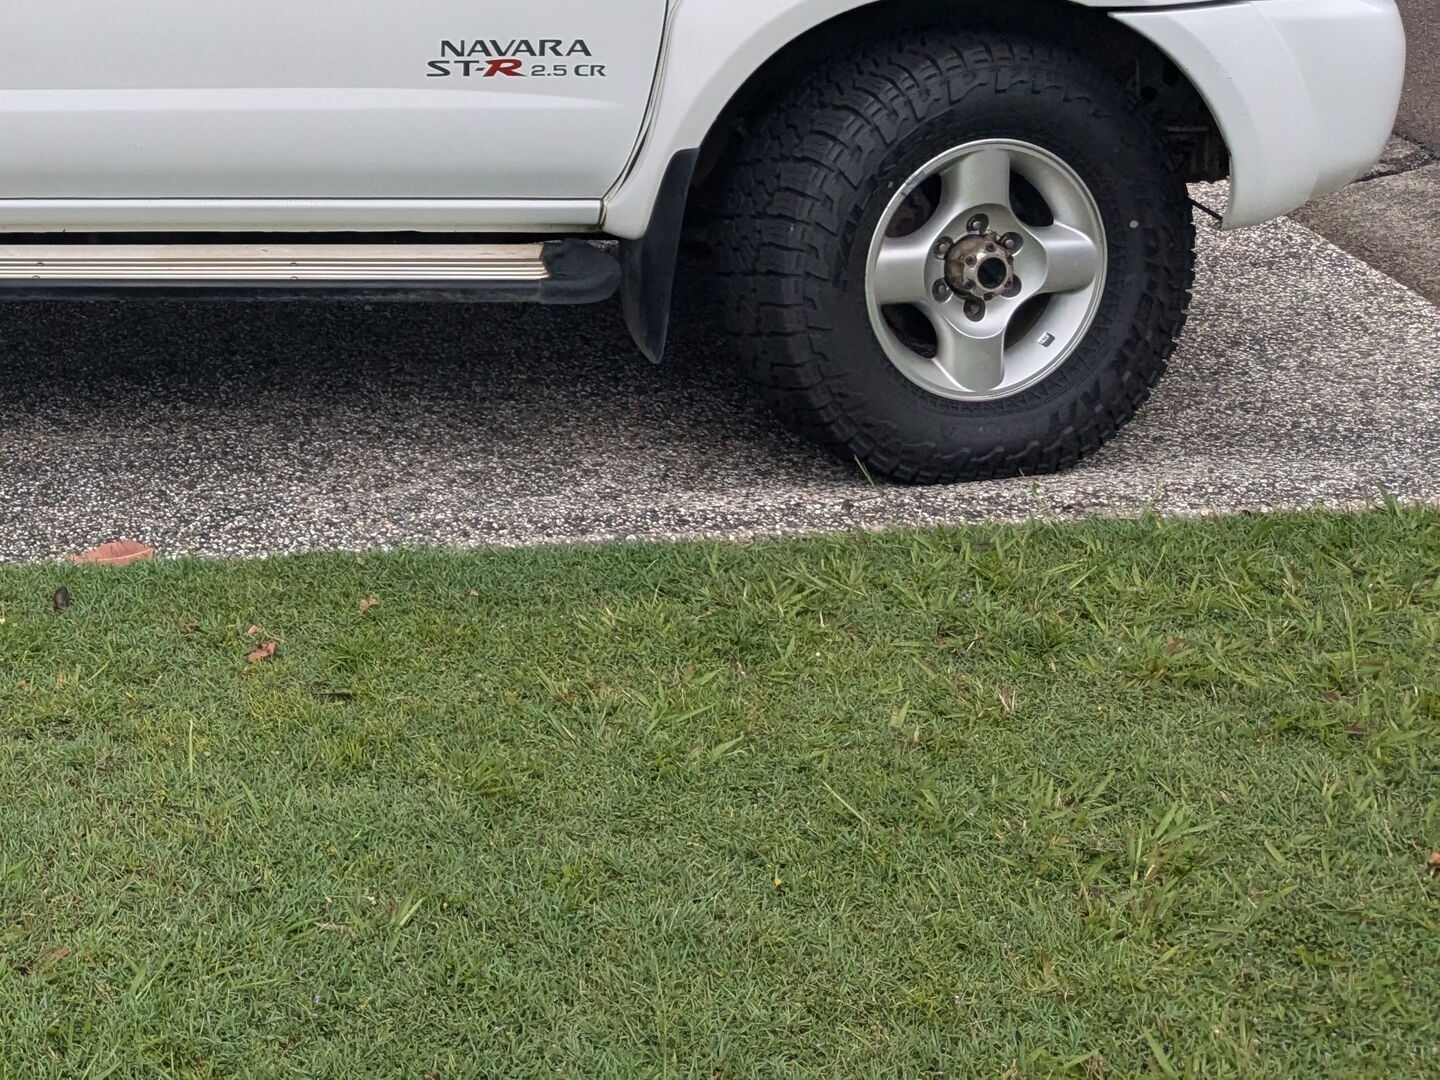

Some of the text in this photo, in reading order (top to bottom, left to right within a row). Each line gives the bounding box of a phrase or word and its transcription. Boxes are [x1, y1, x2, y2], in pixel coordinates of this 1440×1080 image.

[439, 38, 593, 58] NAVARA
[425, 58, 607, 78] ST-R 2.5 CR
